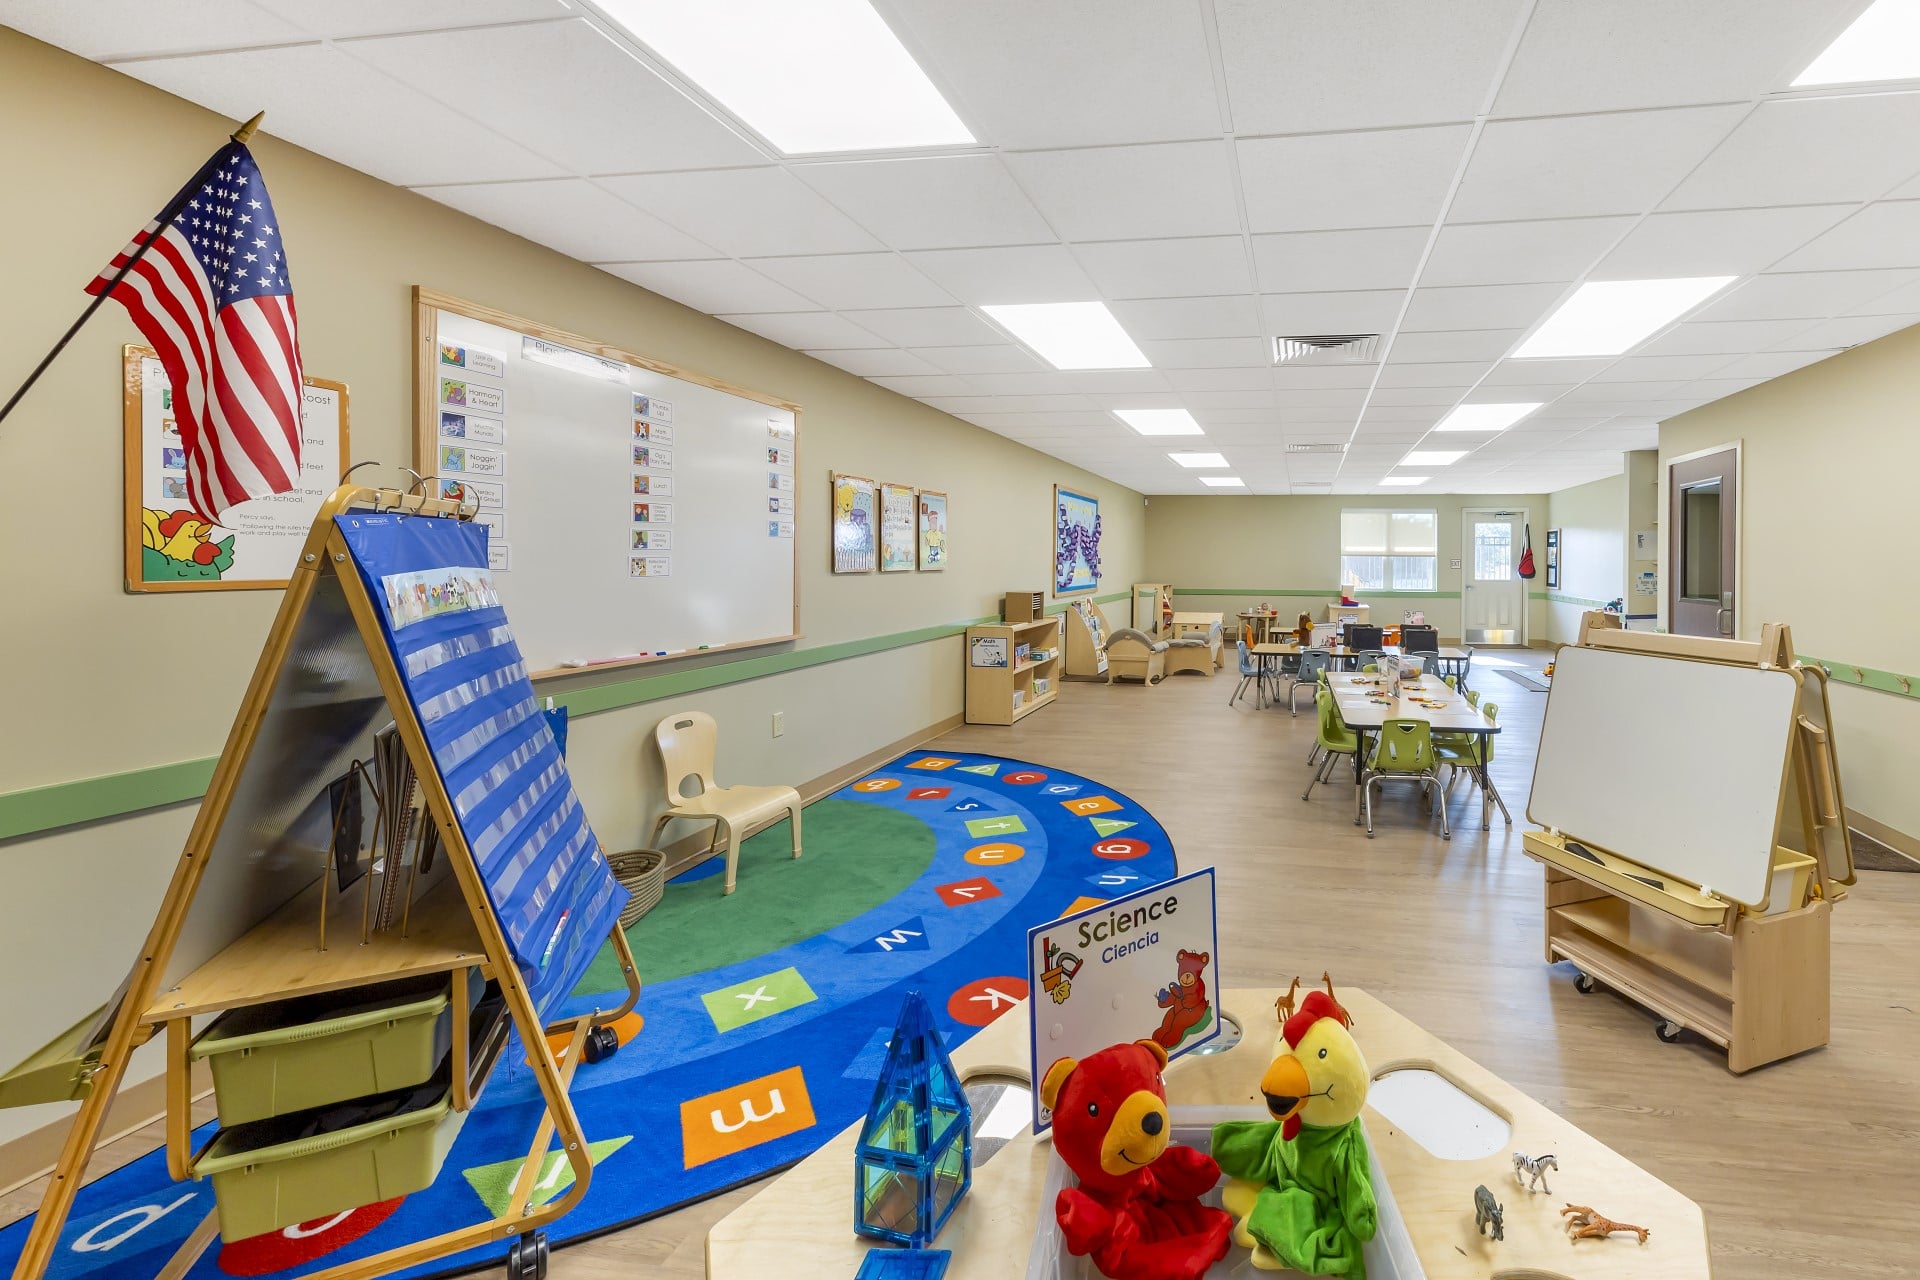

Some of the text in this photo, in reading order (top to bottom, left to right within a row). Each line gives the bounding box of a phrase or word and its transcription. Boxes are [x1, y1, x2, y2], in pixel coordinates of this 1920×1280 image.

[469, 389, 500, 401] Harmony
[303, 396, 331, 404] oost
[479, 399, 498, 408] Heart
[306, 438, 324, 446] and
[470, 454, 498, 463] Noggin'
[471, 462, 497, 471] Joggin'
[1078, 896, 1178, 949] Science
[1102, 932, 1159, 964] Ciencia
